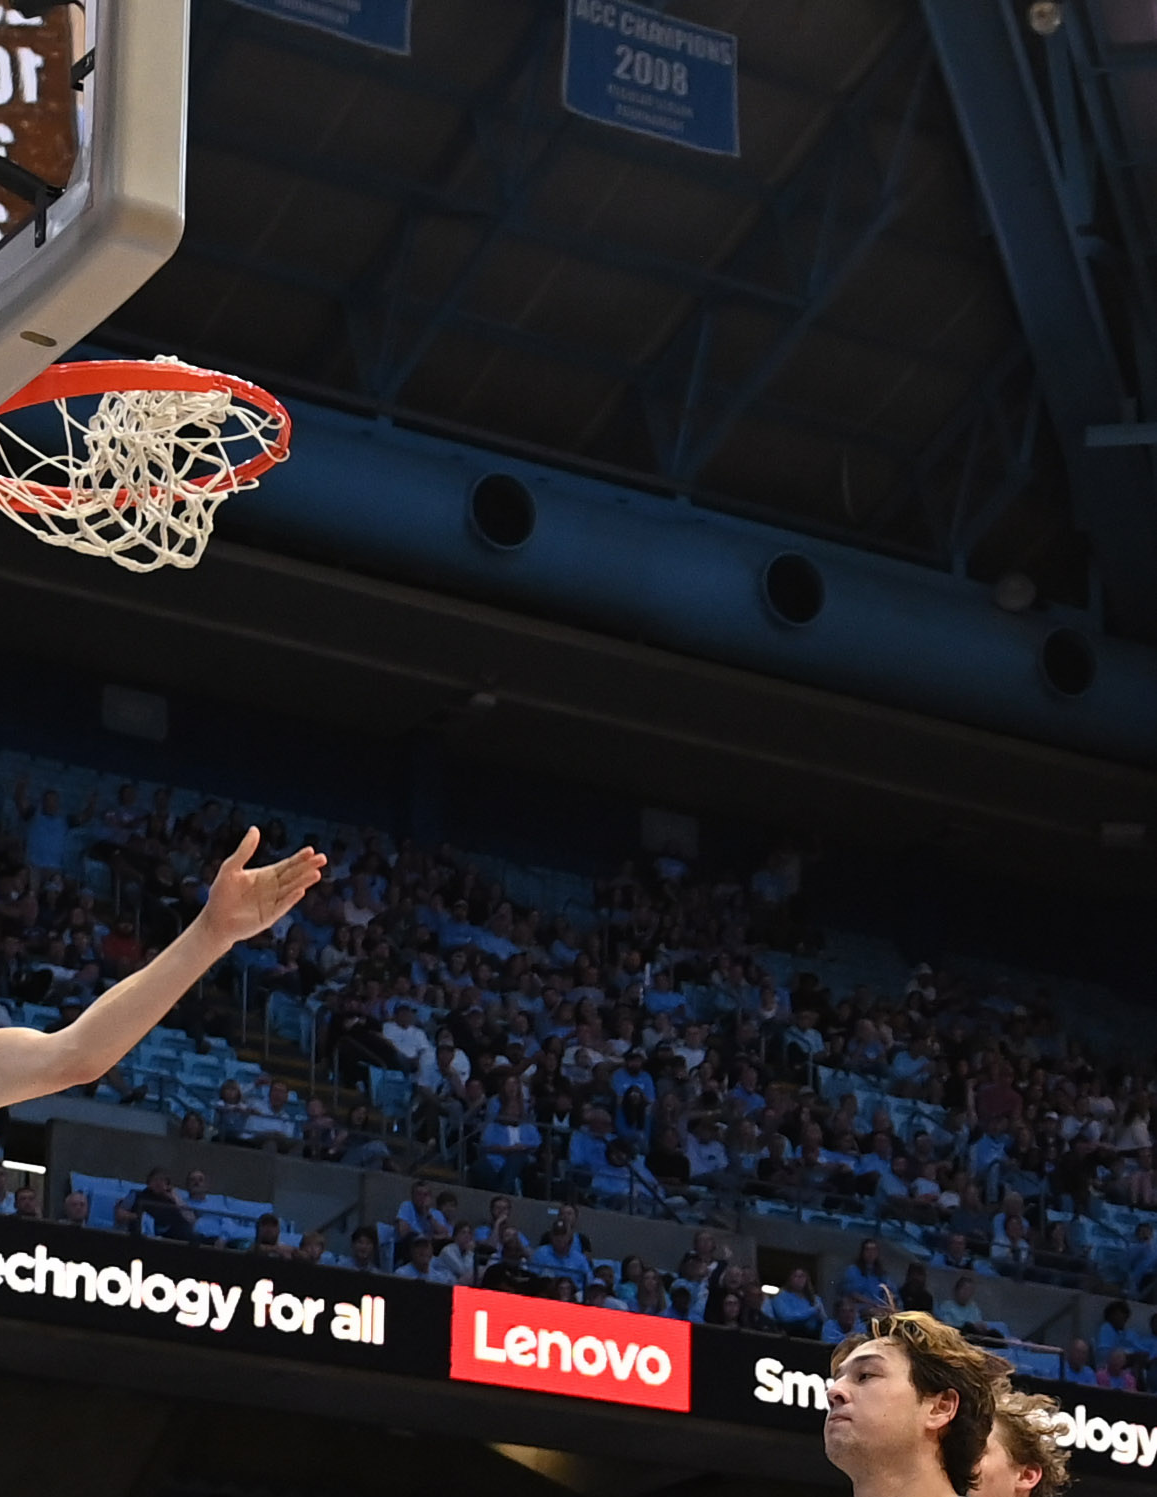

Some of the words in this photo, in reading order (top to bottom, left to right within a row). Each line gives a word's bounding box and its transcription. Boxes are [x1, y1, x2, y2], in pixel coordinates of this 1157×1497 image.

[620, 11, 733, 66] CHAMPIONS
[612, 44, 690, 96] 2008
[250, 1278, 325, 1335] for
[329, 1295, 386, 1345] all
[474, 1310, 673, 1386] Lenovo
[753, 1357, 835, 1411] Sm
